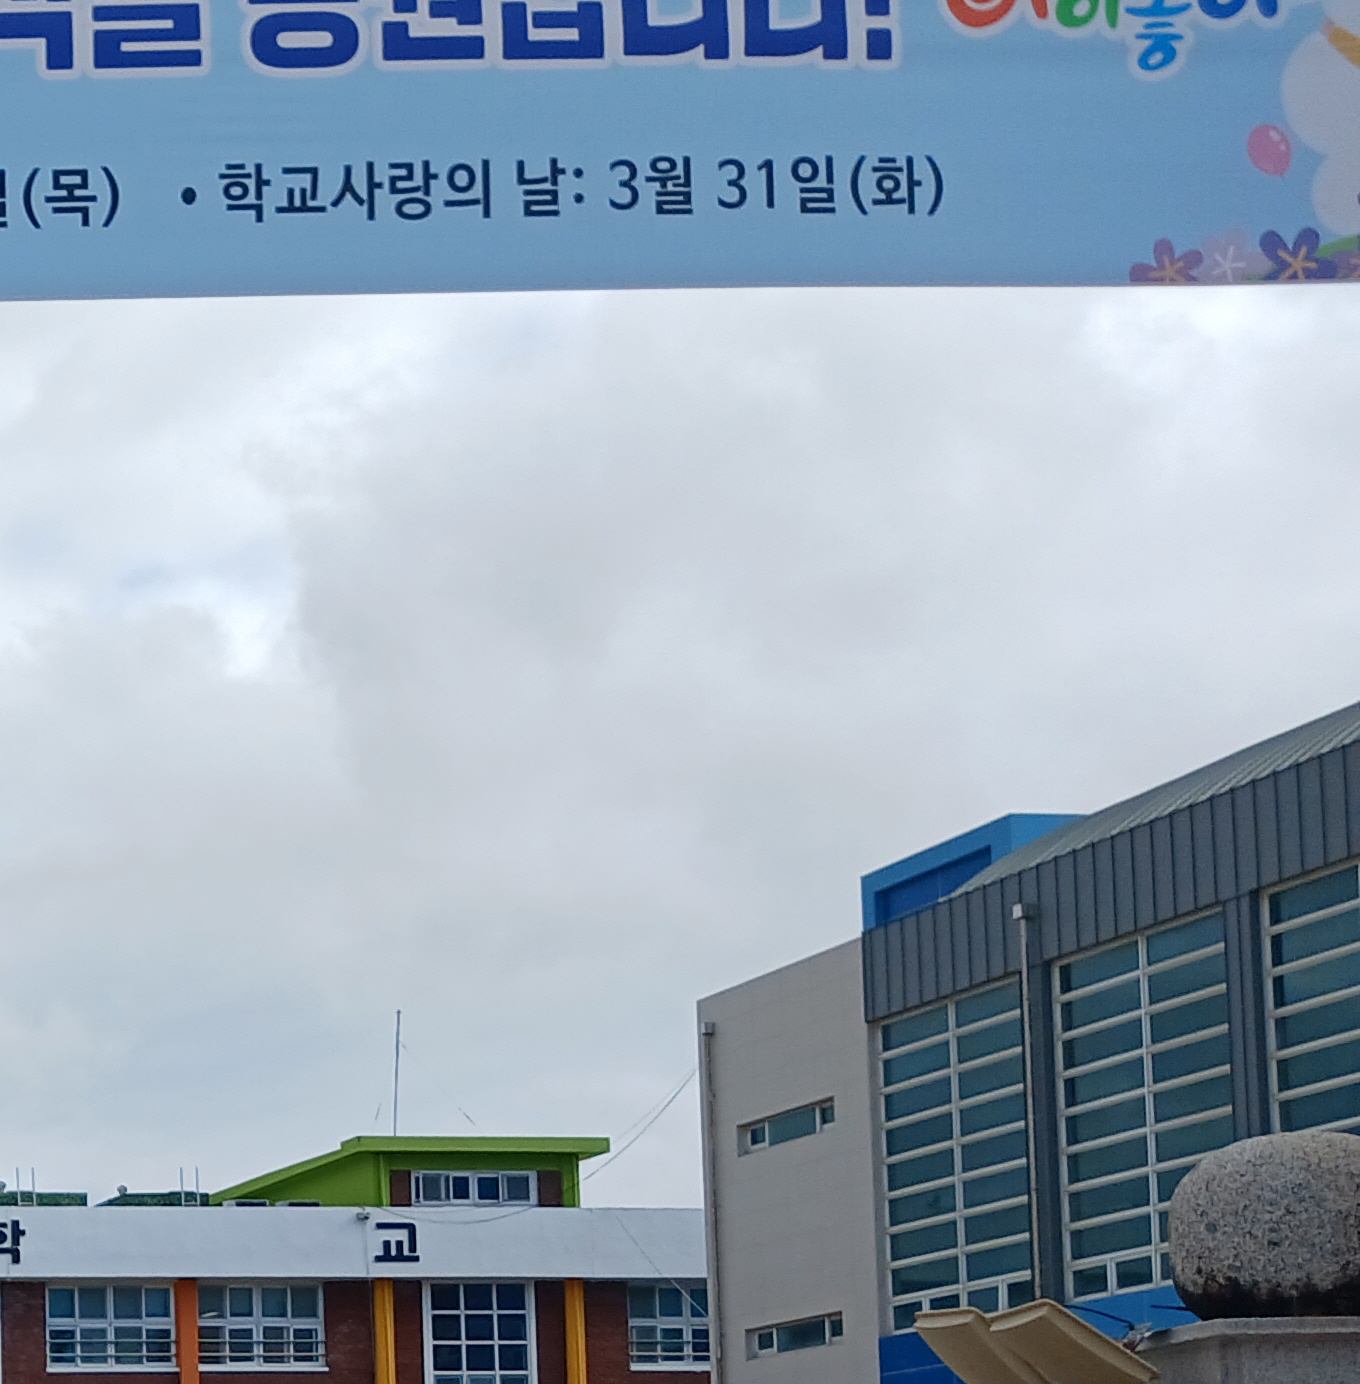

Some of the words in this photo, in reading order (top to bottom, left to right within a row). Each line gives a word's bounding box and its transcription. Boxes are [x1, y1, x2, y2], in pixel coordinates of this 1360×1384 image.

[216, 157, 494, 222] 학교사랑의
[514, 156, 588, 217] 날:
[606, 154, 696, 215] 3월
[716, 153, 945, 216] 31일(화)
[374, 1221, 421, 1263] 교
